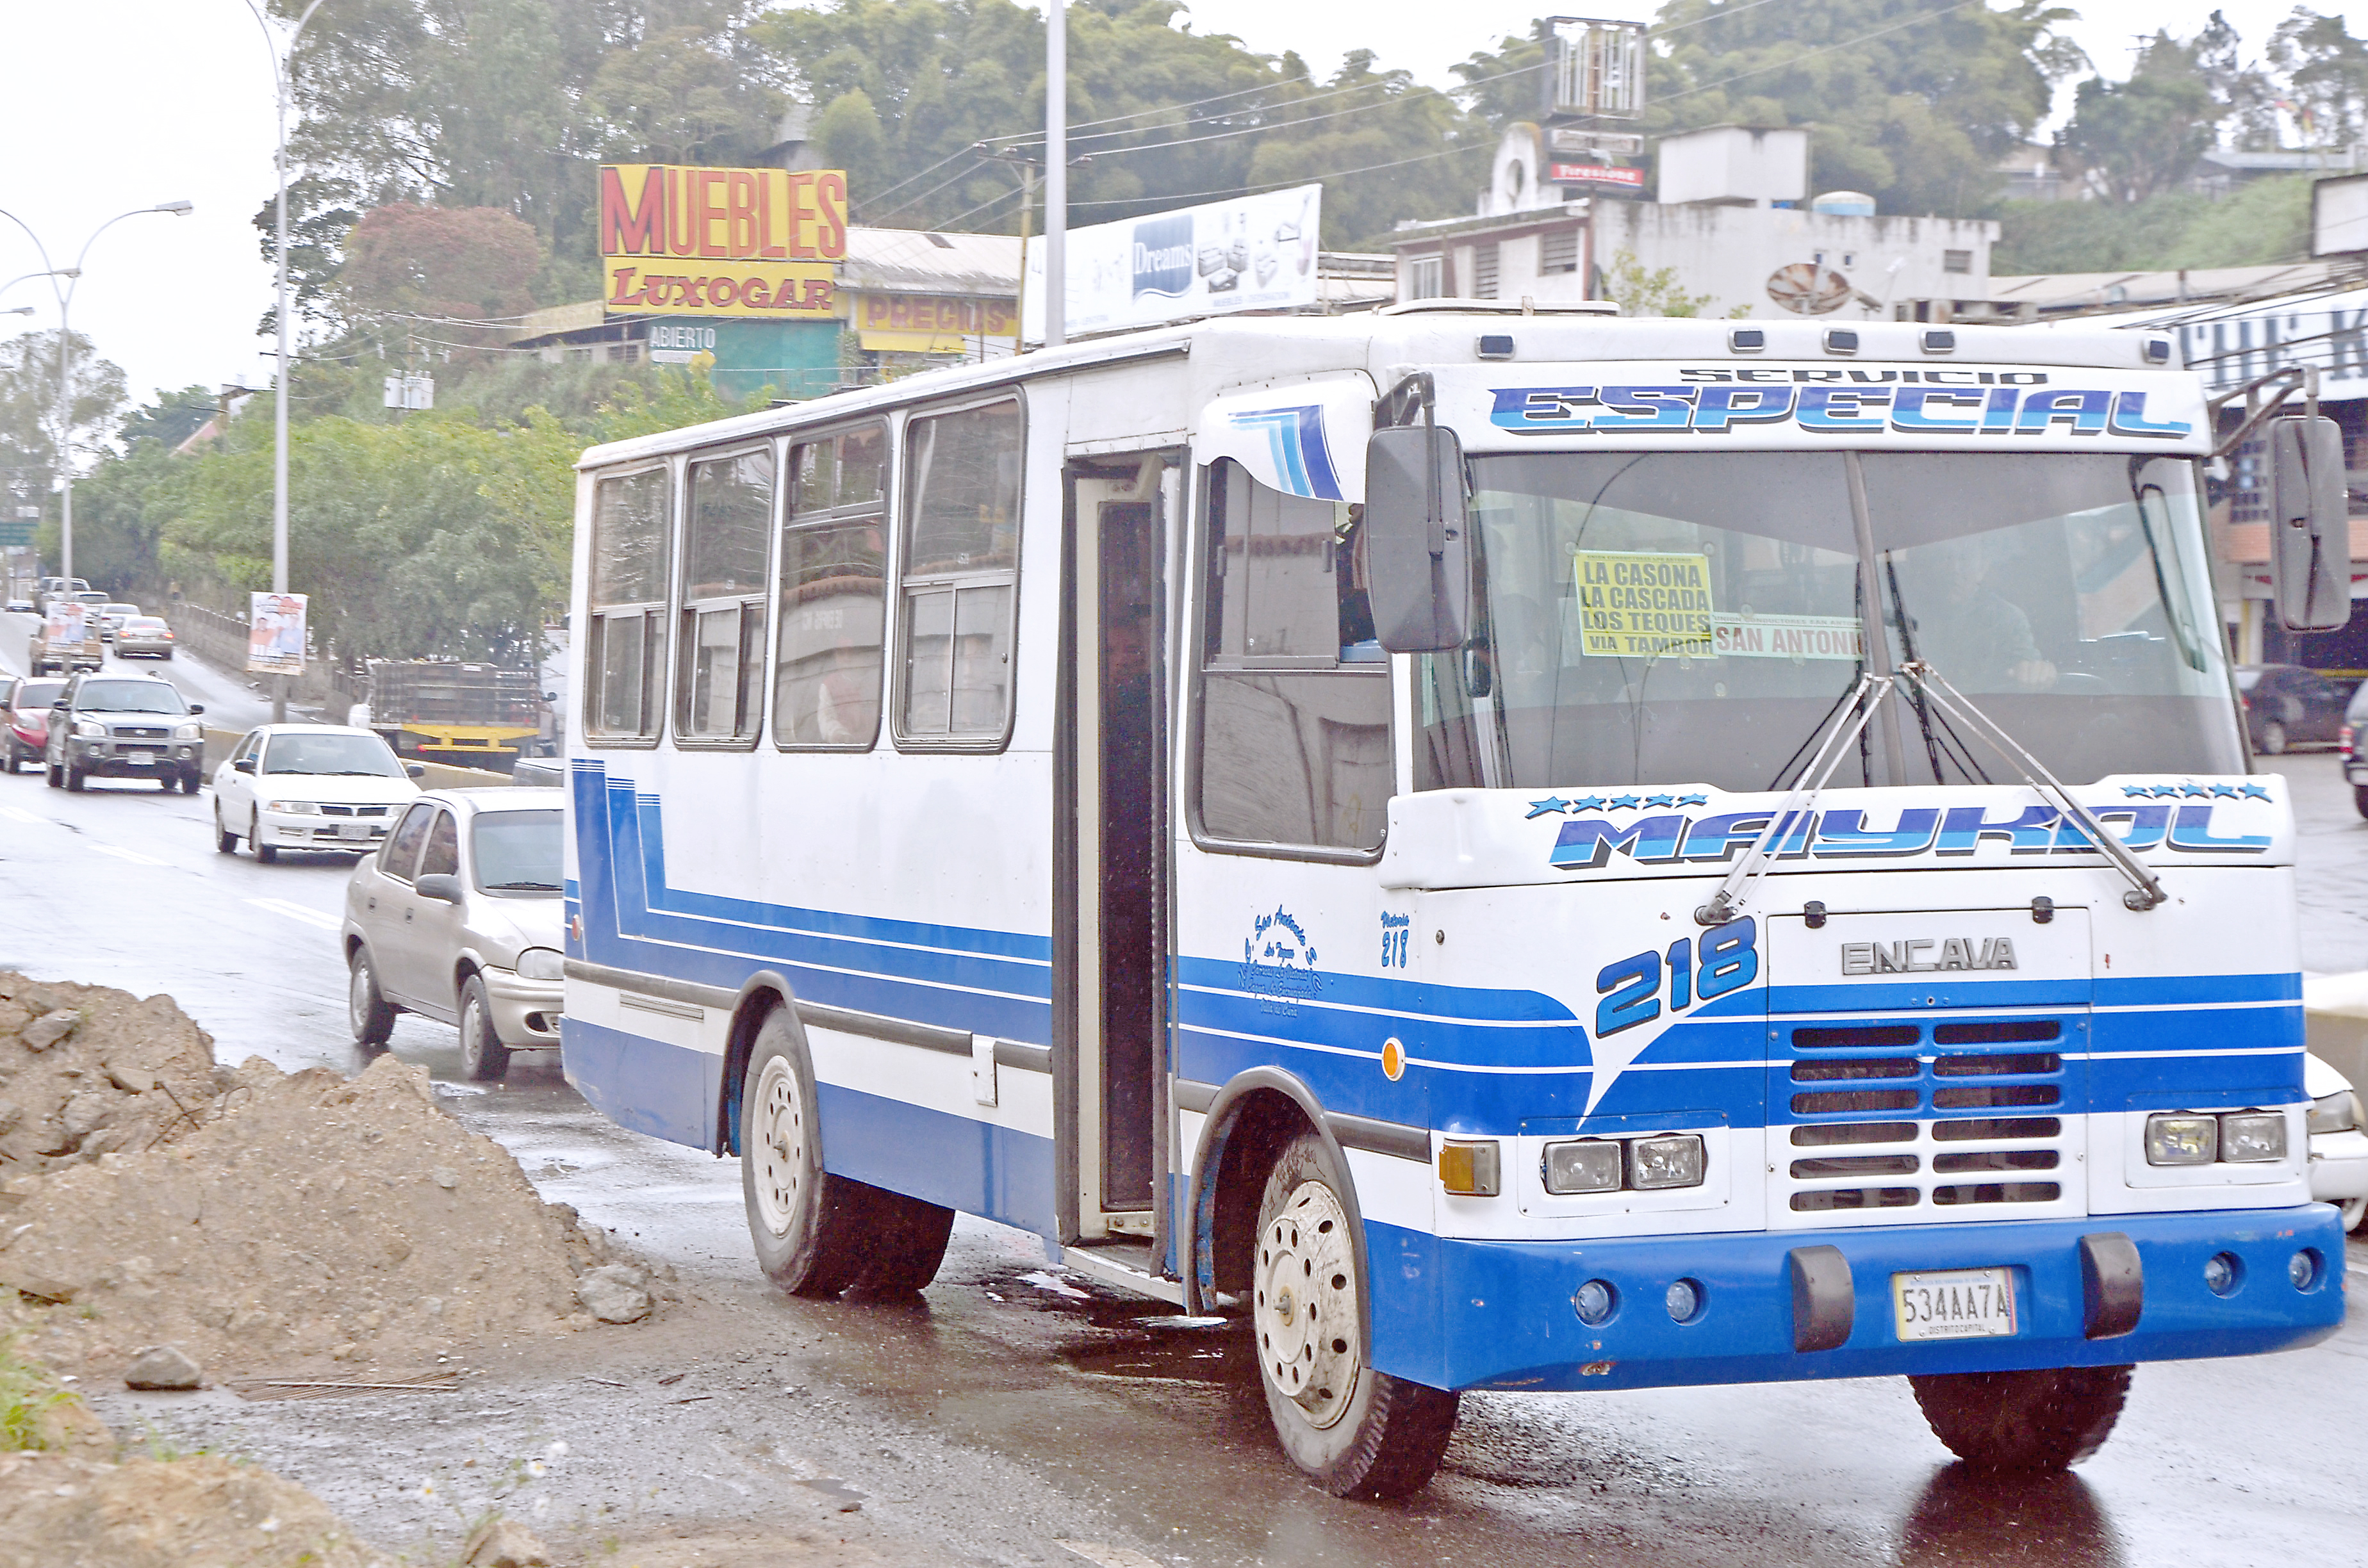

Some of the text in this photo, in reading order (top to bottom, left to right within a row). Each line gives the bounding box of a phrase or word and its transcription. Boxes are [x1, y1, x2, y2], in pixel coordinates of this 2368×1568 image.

[1559, 165, 1635, 181] Firestone
[601, 167, 846, 258] MUEBLES
[1133, 242, 1192, 274] Dreams
[609, 266, 834, 310] LUXOGAR
[867, 296, 1005, 332] PRECIOS
[649, 325, 716, 349] ABIERTO
[1681, 370, 2048, 384] SERVICIO
[1488, 386, 2192, 439] ESPECIAL
[1584, 562, 1702, 587] LA CASONA
[1581, 586, 1709, 612] LA CASCADA
[1583, 610, 1711, 633] LOS TEQUES
[1590, 636, 1618, 650] VIA
[1716, 626, 1763, 652] SAN
[1548, 804, 2273, 871] MAYKOL
[1381, 929, 1408, 968] 218
[1842, 937, 2018, 976] ENCAVA
[1595, 915, 1759, 1040] 218
[1903, 1285, 2009, 1322] 534AA7A
